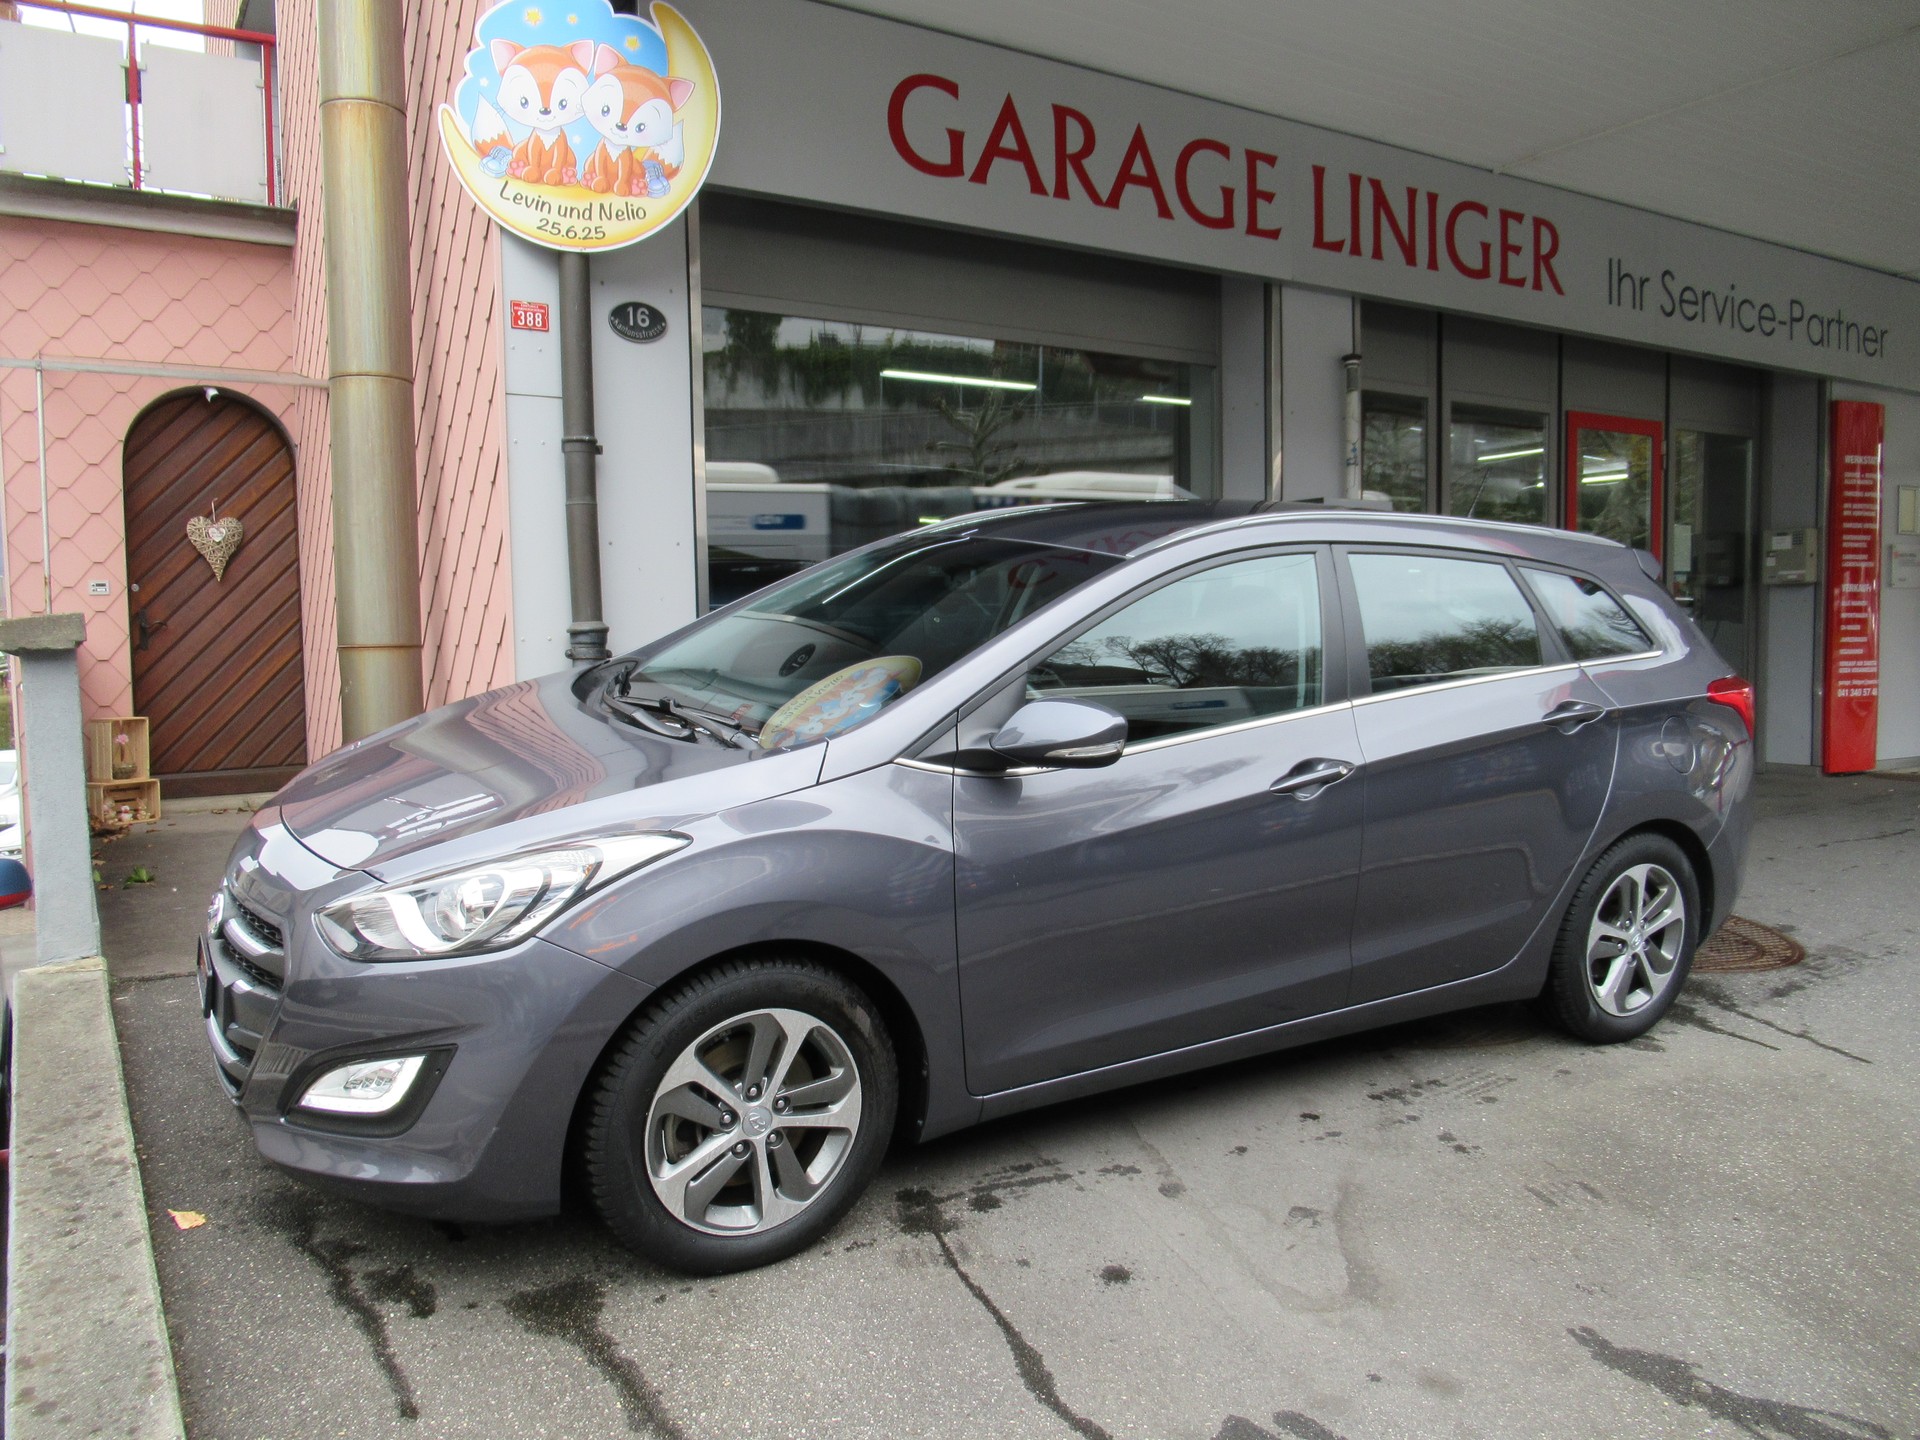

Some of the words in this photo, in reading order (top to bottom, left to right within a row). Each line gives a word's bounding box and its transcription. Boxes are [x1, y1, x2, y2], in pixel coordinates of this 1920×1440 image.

[887, 73, 1282, 240] GARAGE
[1311, 164, 1566, 297] LINIGER
[499, 180, 552, 215] Levin
[557, 202, 593, 221] und
[599, 201, 647, 221] Nelio
[536, 217, 607, 241] 25.6.25
[517, 310, 543, 328] 388
[626, 305, 650, 328] 16
[1608, 257, 1650, 311] Ihr
[1660, 269, 1888, 358] Service-Partner
[613, 317, 663, 339] Kantonsstrasse
